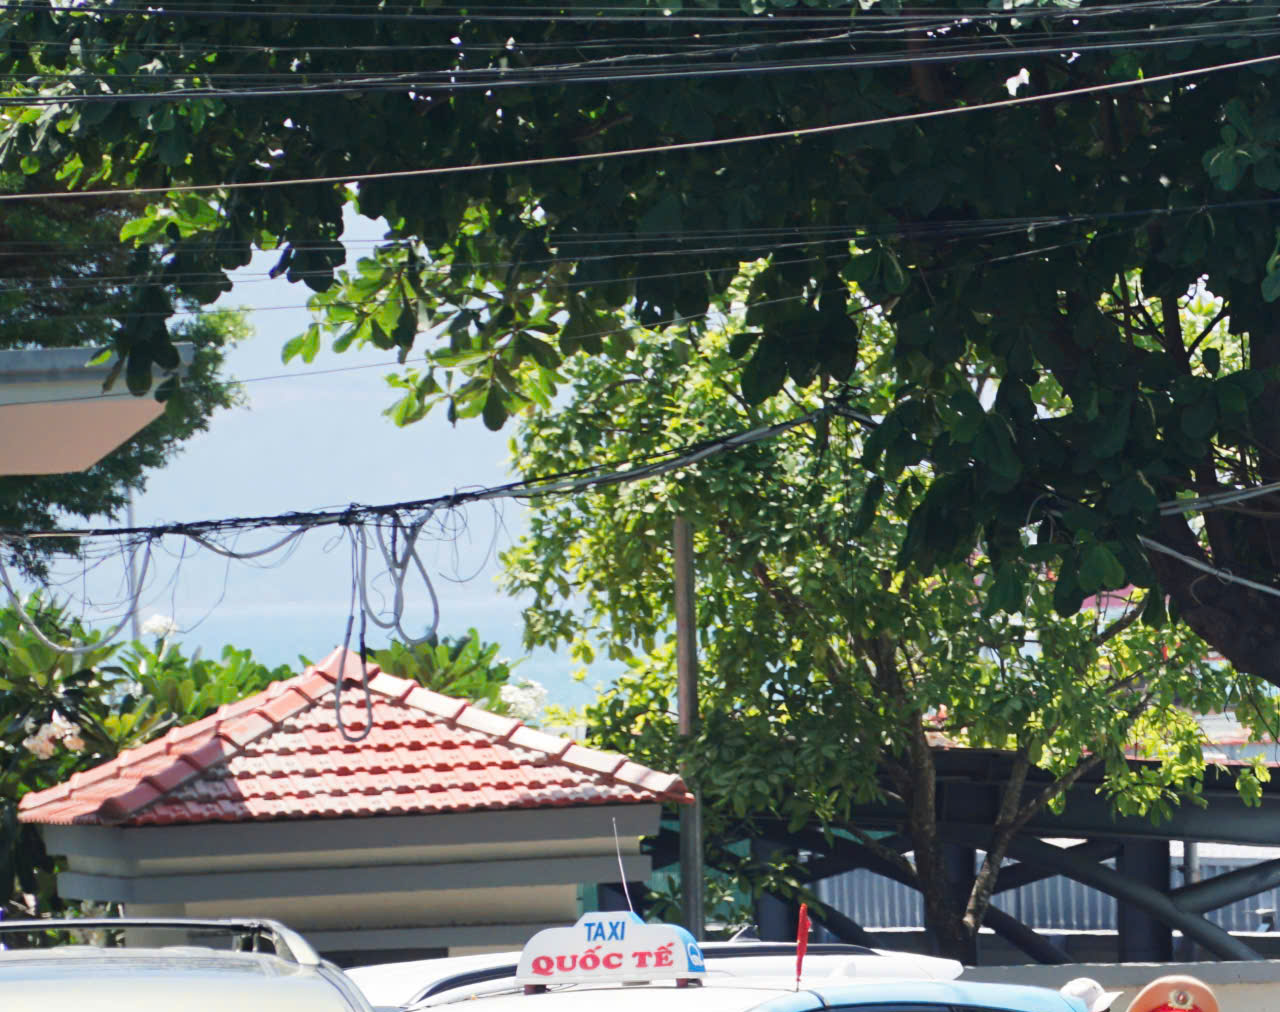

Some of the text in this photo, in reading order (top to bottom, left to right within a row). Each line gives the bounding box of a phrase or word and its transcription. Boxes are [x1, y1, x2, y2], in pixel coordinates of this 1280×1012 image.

[584, 921, 625, 941] TAXI
[531, 942, 675, 976] QUỐC TẾ
